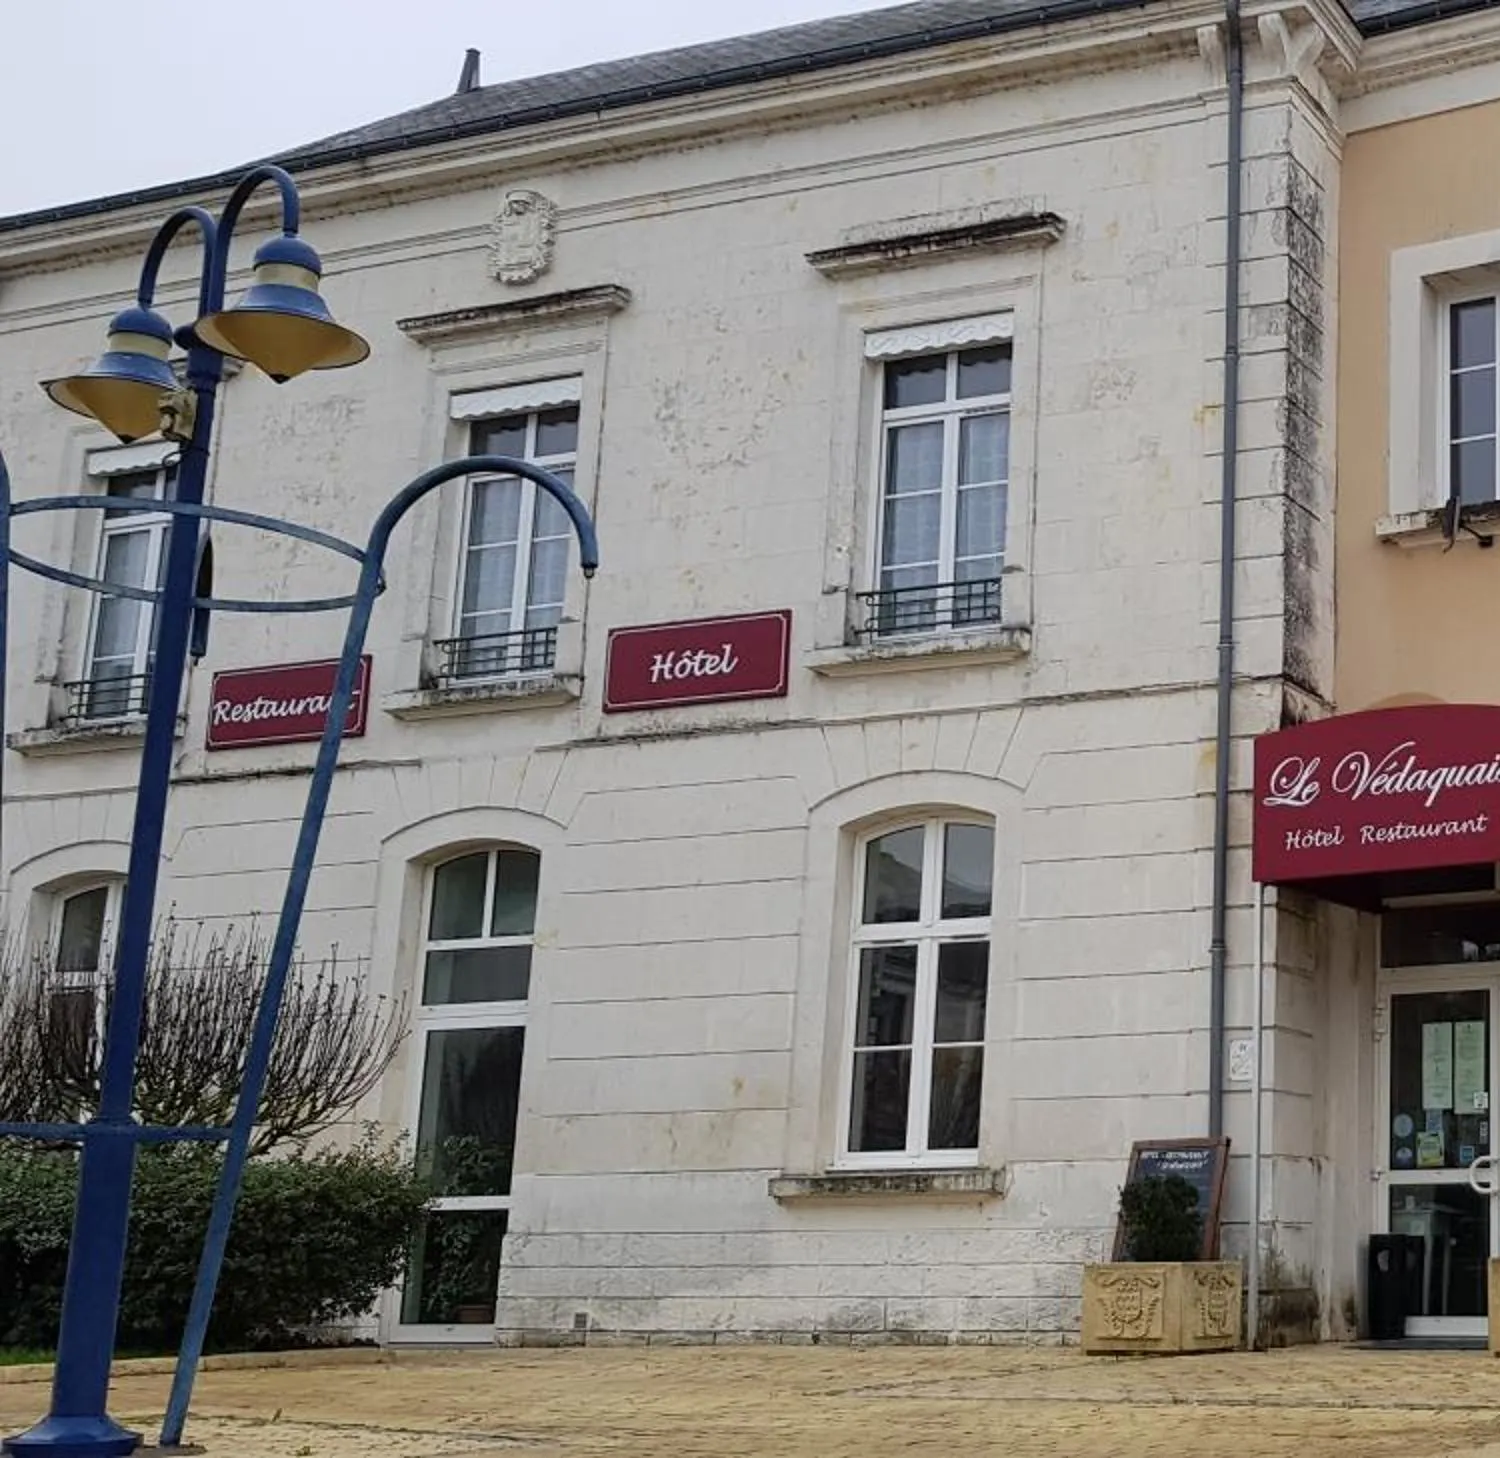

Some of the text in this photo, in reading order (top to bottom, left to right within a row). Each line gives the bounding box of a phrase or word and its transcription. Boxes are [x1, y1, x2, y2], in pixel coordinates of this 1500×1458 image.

[649, 643, 739, 683] Hôtel
[213, 689, 361, 726] Restaura
[1263, 756, 1321, 807] Le
[1285, 813, 1489, 851] Hôtel Restaurant
